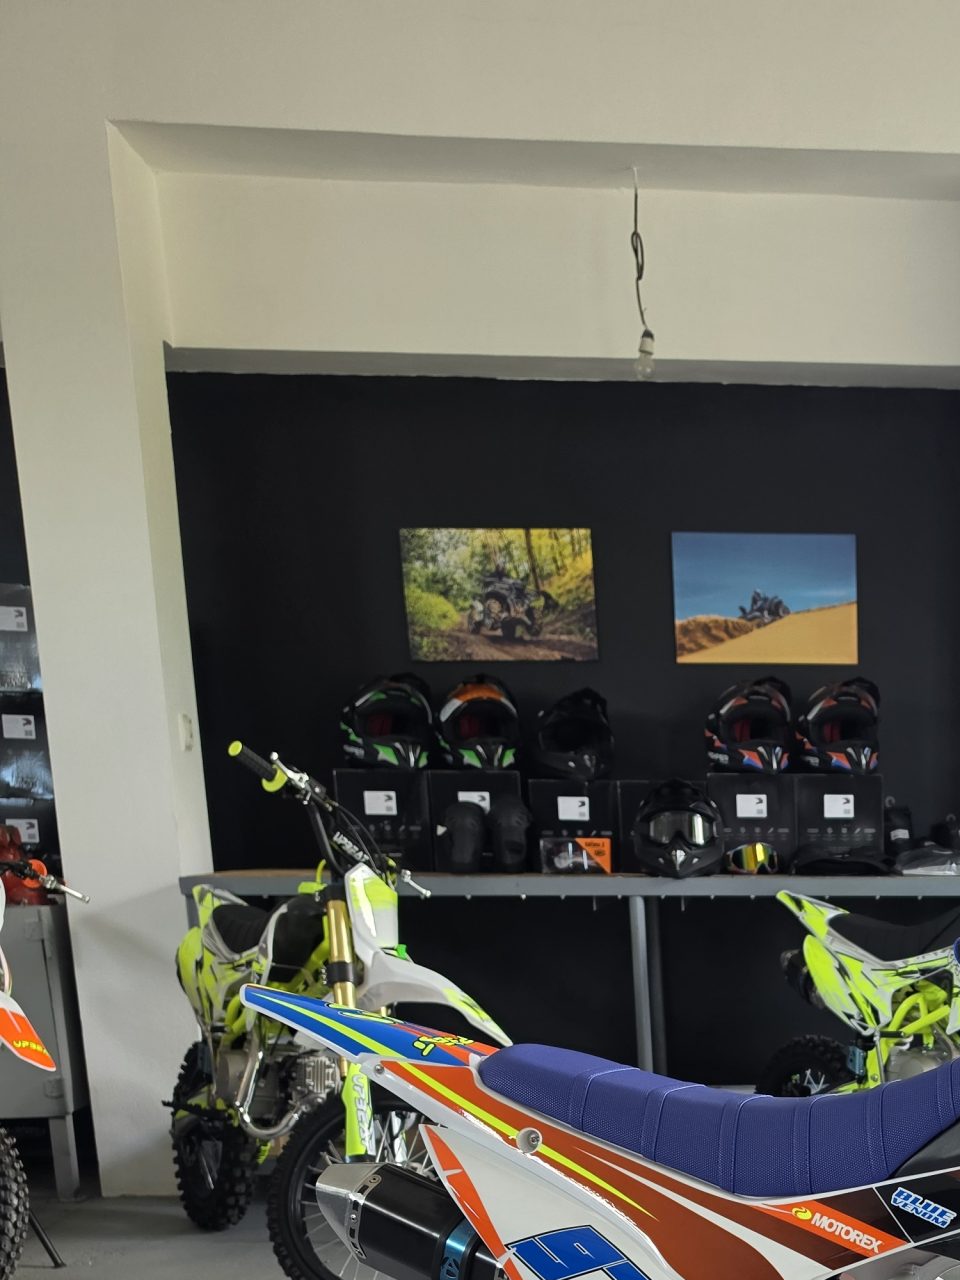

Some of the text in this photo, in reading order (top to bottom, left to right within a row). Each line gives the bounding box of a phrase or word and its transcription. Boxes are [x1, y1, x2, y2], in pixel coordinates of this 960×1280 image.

[891, 1195, 950, 1229] VENOM
[894, 1187, 957, 1221] BLUE
[811, 1212, 883, 1253] MOTOREX
